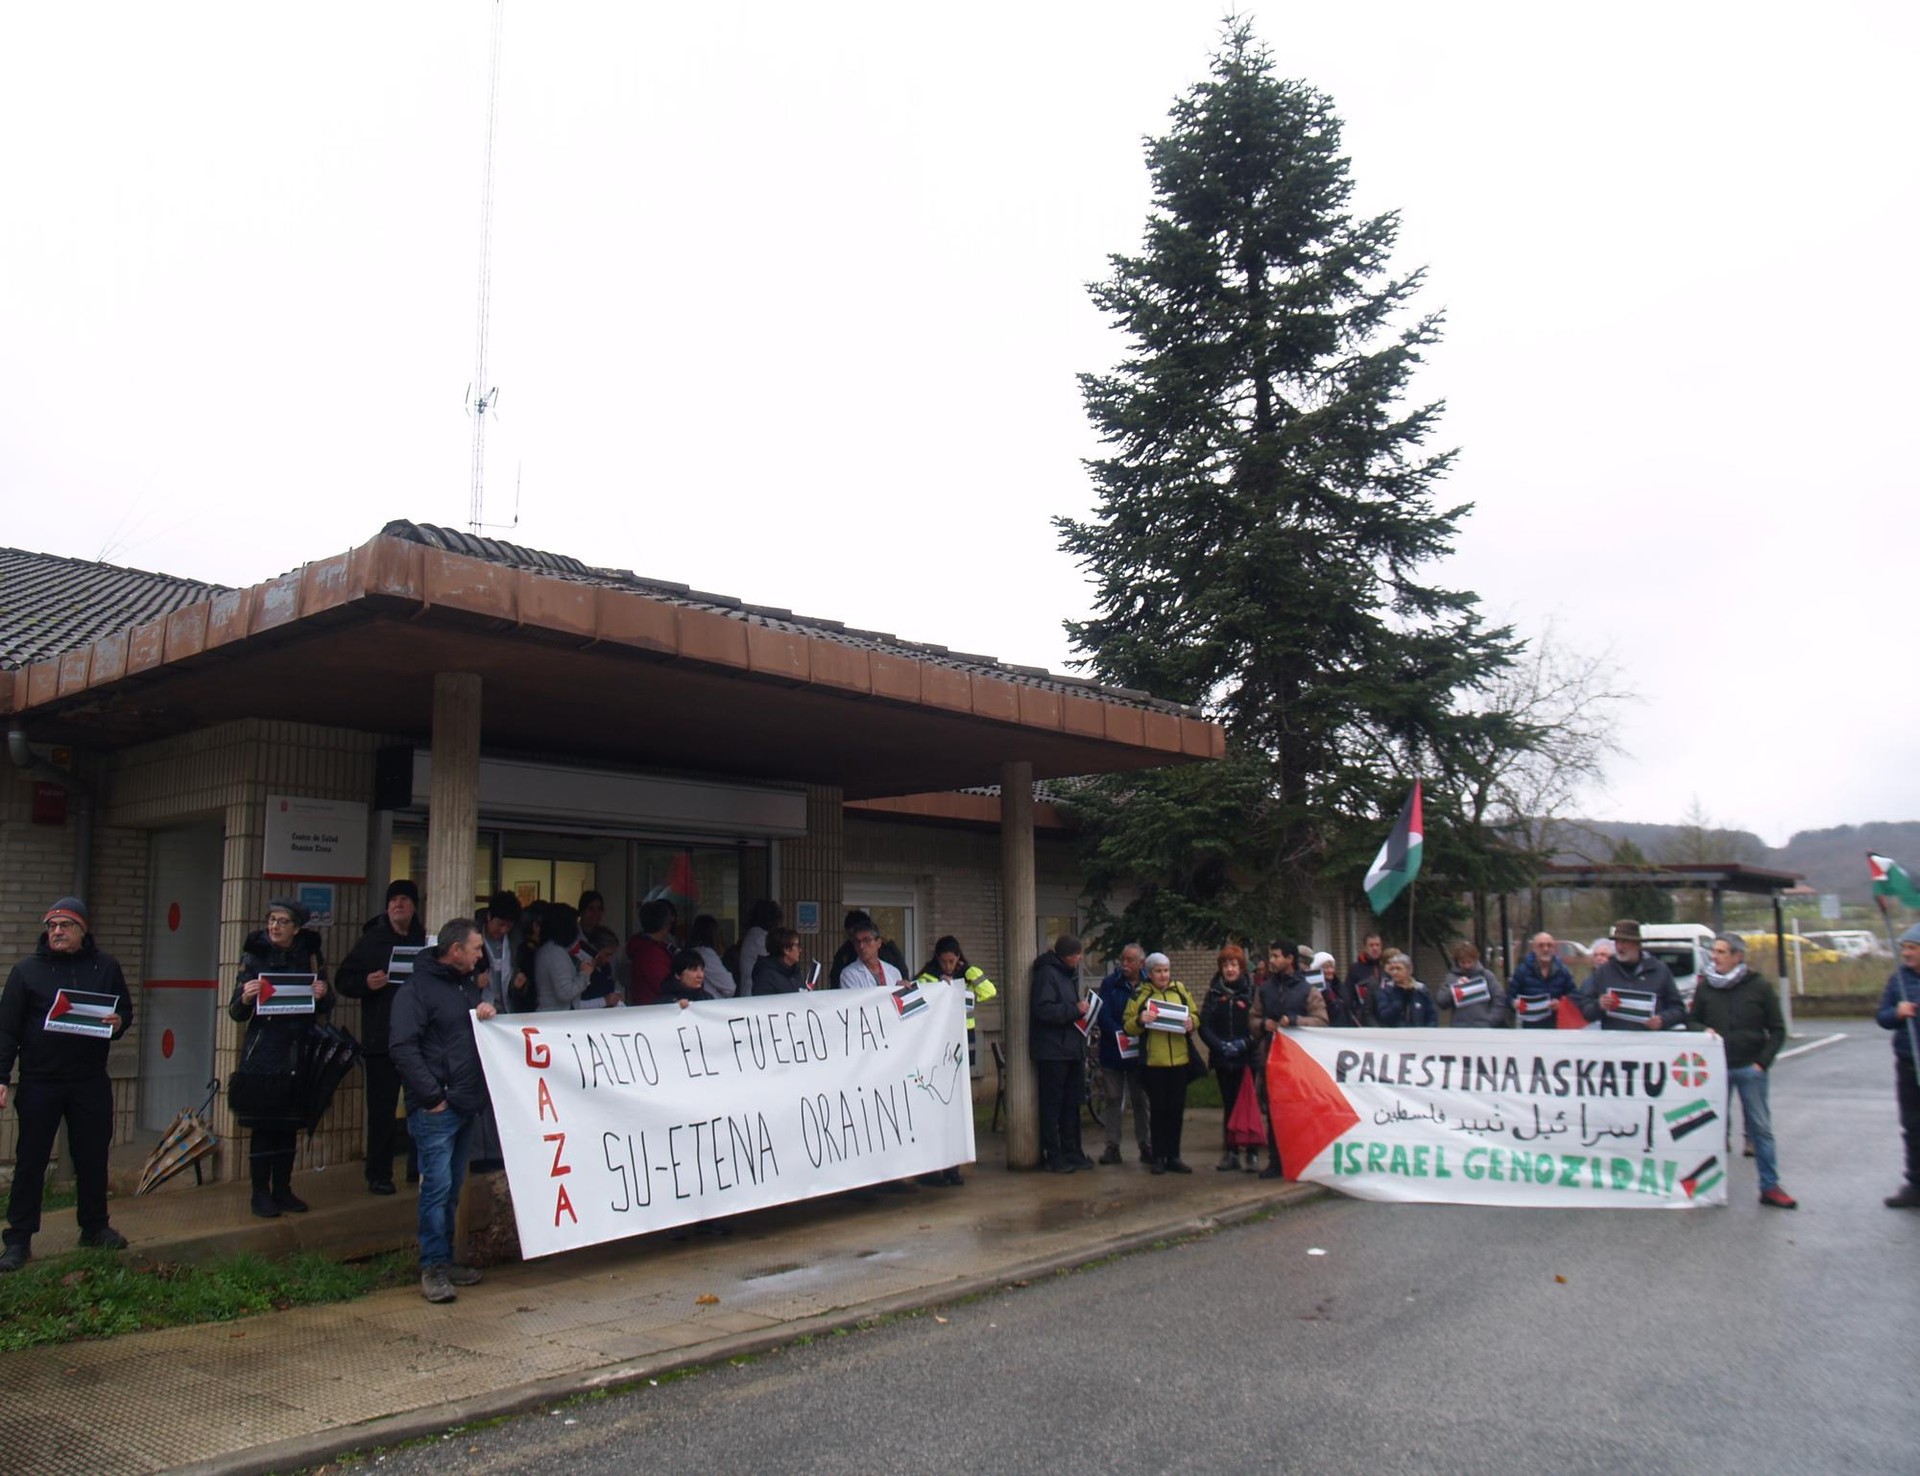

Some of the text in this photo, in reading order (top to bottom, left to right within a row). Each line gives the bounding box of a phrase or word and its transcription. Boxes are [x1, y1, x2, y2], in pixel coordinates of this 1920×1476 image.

[677, 1026, 720, 1078] EL
[728, 1009, 828, 1072] FUEGO
[837, 1006, 889, 1056] YA!
[1335, 1050, 1667, 1098] PALESTINA ASKATU
[522, 1026, 578, 1228] GAZA
[603, 1112, 779, 1212] SU-ETENA
[1333, 1142, 1678, 1198] ISRAEL GENOZIDA!
